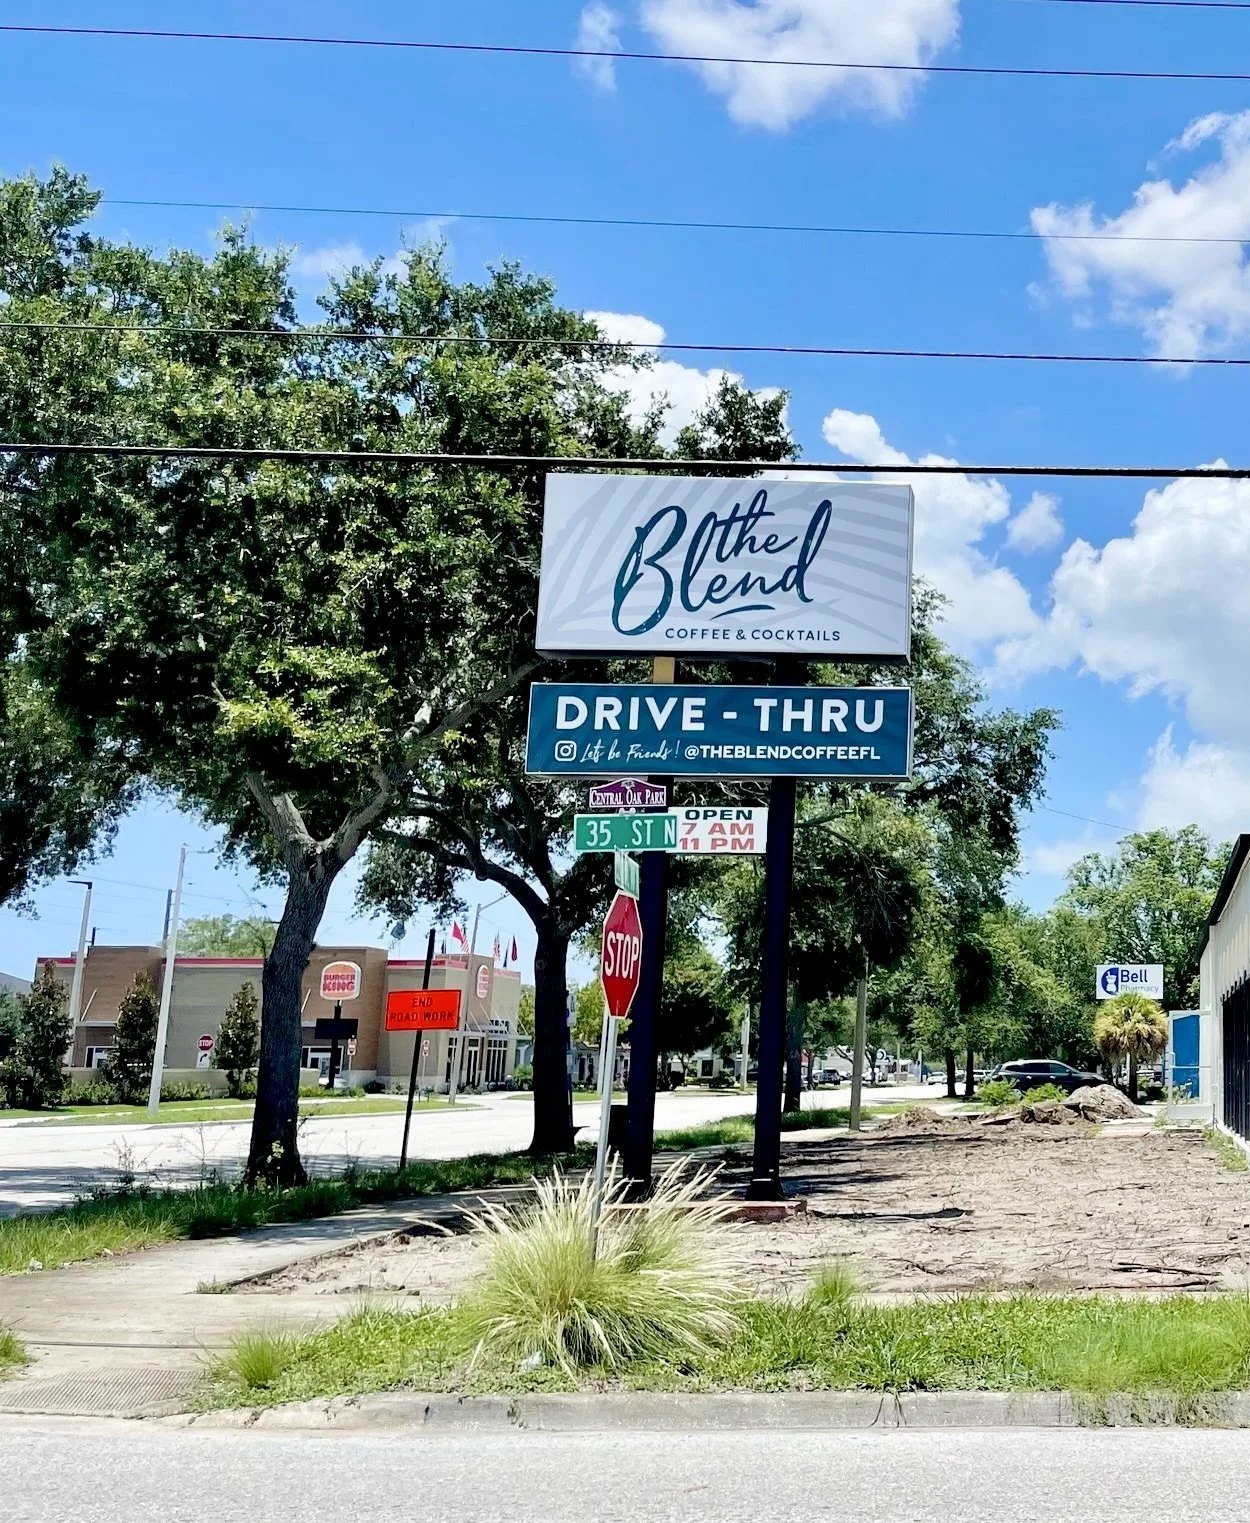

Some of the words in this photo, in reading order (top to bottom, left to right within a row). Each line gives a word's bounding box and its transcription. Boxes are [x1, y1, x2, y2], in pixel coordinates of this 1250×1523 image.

[715, 489, 798, 563] the
[612, 499, 832, 636] Blend
[665, 628, 731, 640] COFFEE
[735, 629, 747, 640] &
[751, 629, 841, 641] COCKTAILS
[556, 695, 706, 731] DRIVE
[753, 698, 885, 733] THRU
[607, 739, 621, 760] be
[684, 745, 881, 760] @THEBLENDCOFFEEFL
[591, 790, 623, 806] CENTRAL
[626, 789, 642, 805] OAK
[645, 789, 665, 805] PARK
[685, 810, 753, 821] OPEN
[586, 820, 612, 847] 35
[631, 820, 654, 846] ST
[664, 819, 675, 845] N
[682, 823, 697, 835] 7
[708, 823, 754, 835] AM
[679, 838, 699, 850] 11
[711, 838, 755, 850] PM
[604, 930, 640, 979] STOP
[1120, 969, 1148, 983] Bell
[323, 982, 355, 992] KING
[412, 997, 433, 1008] END
[390, 1011, 418, 1023] ROAD
[423, 1010, 455, 1022] WORK
[198, 1039, 213, 1047] STOP
